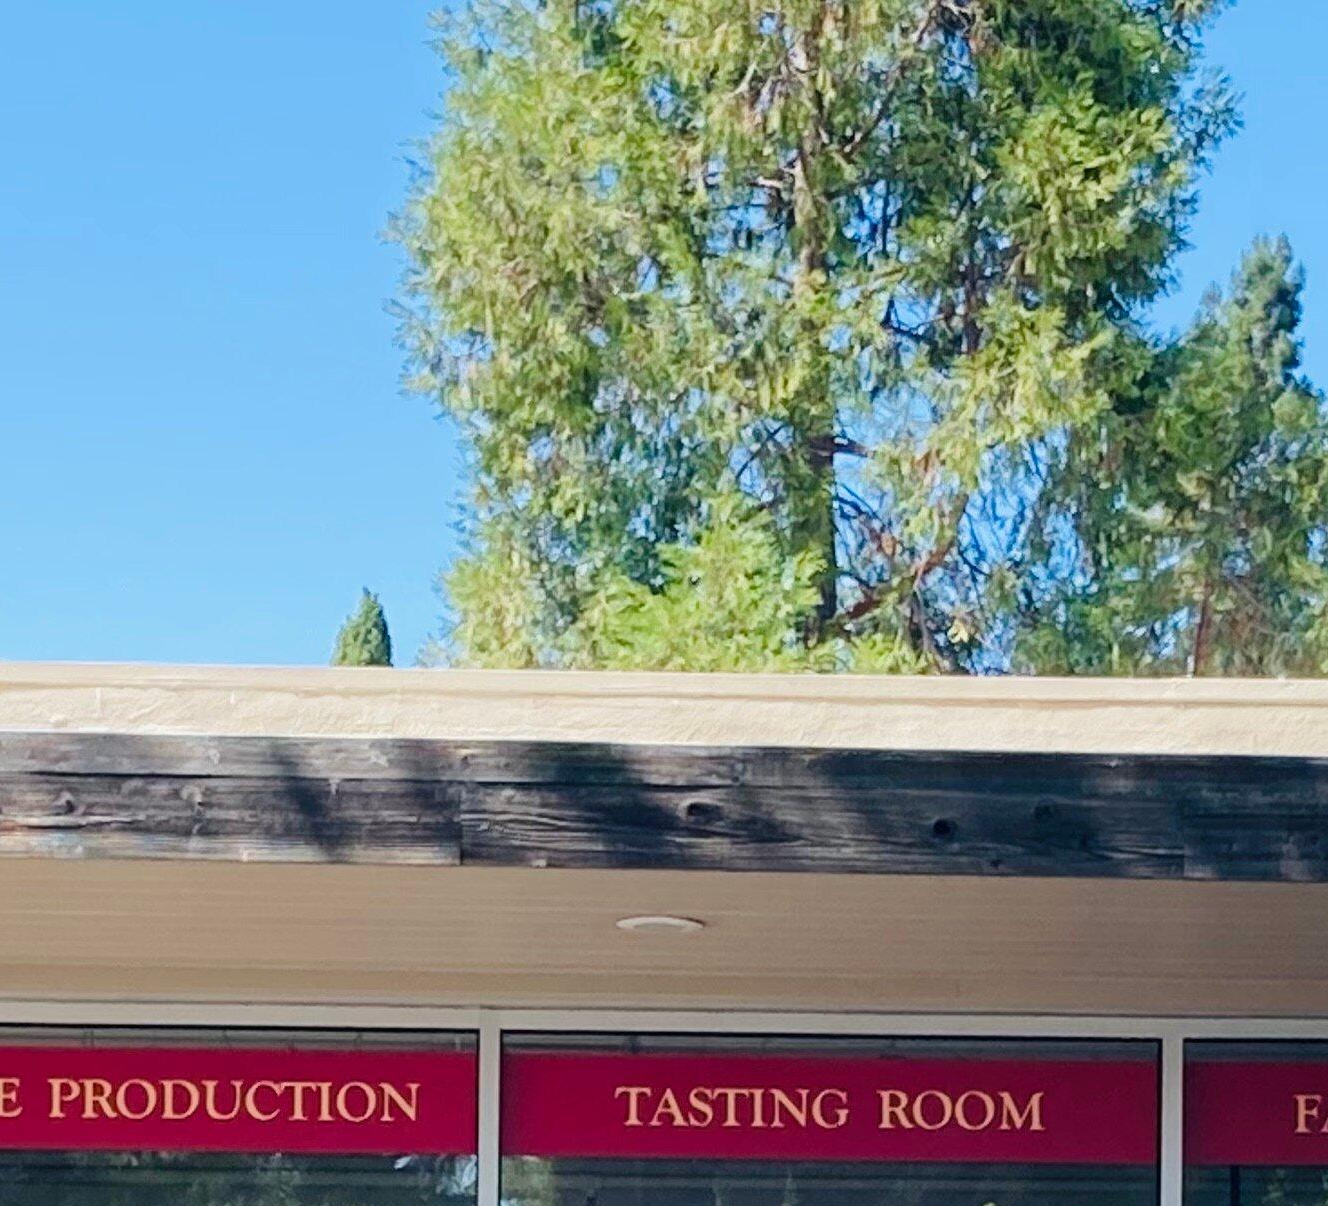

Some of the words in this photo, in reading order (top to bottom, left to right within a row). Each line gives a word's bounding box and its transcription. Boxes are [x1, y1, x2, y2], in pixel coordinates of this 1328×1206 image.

[47, 1077, 421, 1124] PRODUCTION
[615, 1085, 850, 1129] TASTING
[876, 1089, 1047, 1132] ROOM
